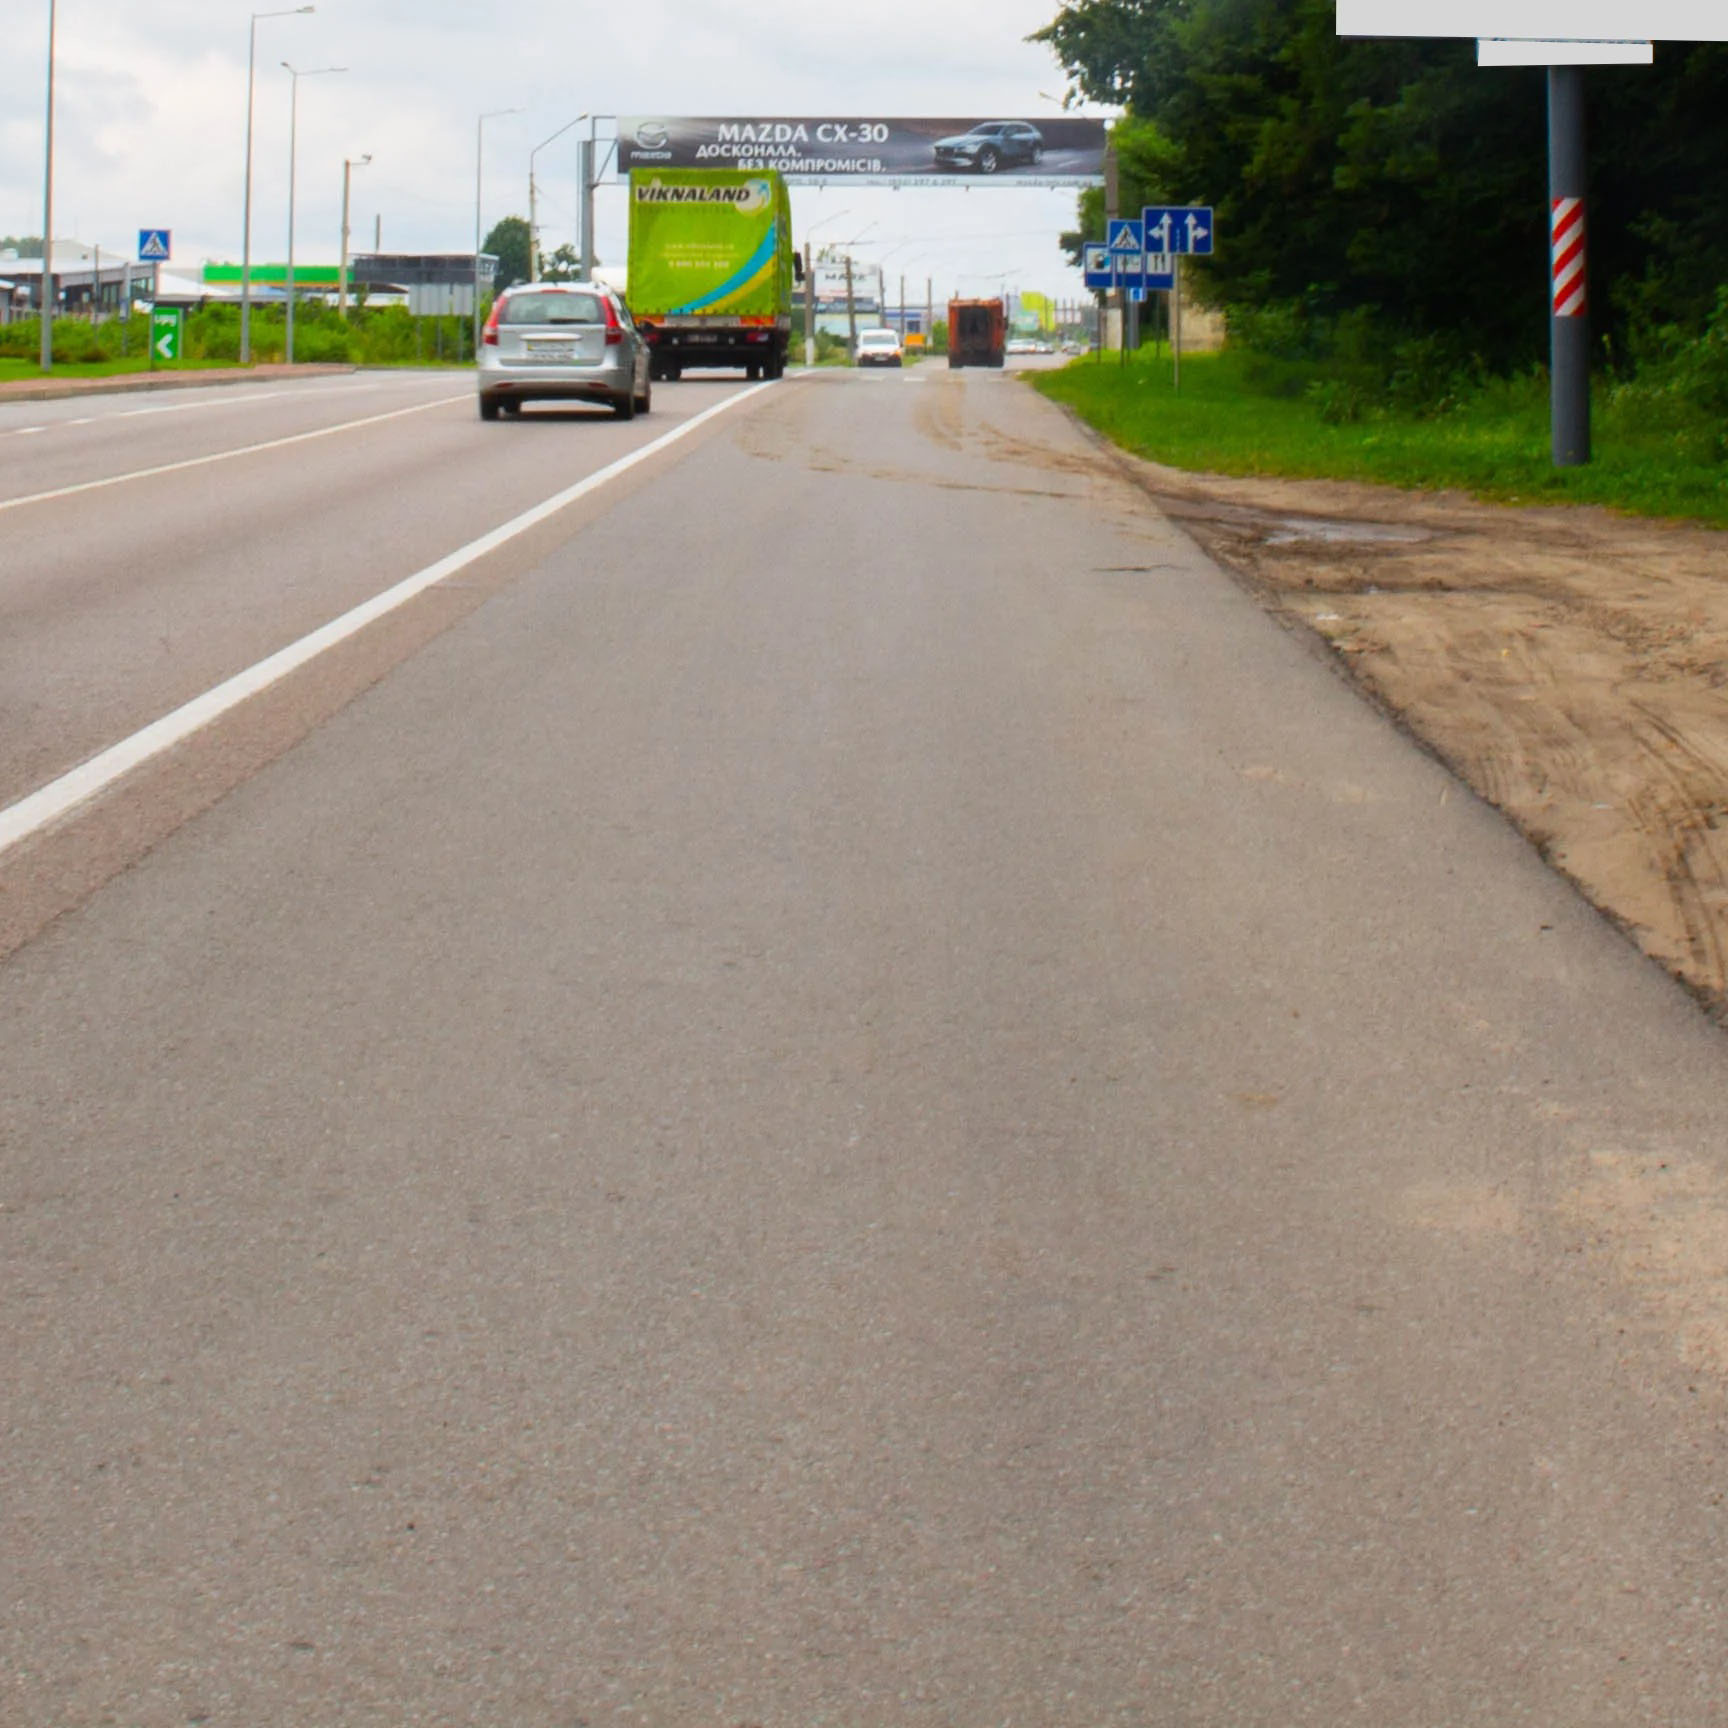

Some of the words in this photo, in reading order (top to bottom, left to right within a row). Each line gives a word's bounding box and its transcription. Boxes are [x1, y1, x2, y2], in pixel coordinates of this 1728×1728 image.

[717, 123, 808, 143] MAZDA
[816, 123, 889, 143] CX-30
[695, 144, 802, 159] ДОСКОНАЛА.
[737, 158, 765, 171] БЕЗ
[768, 158, 887, 173] КОМПРОМІСІВ.
[637, 186, 751, 203] VIKNALAND
